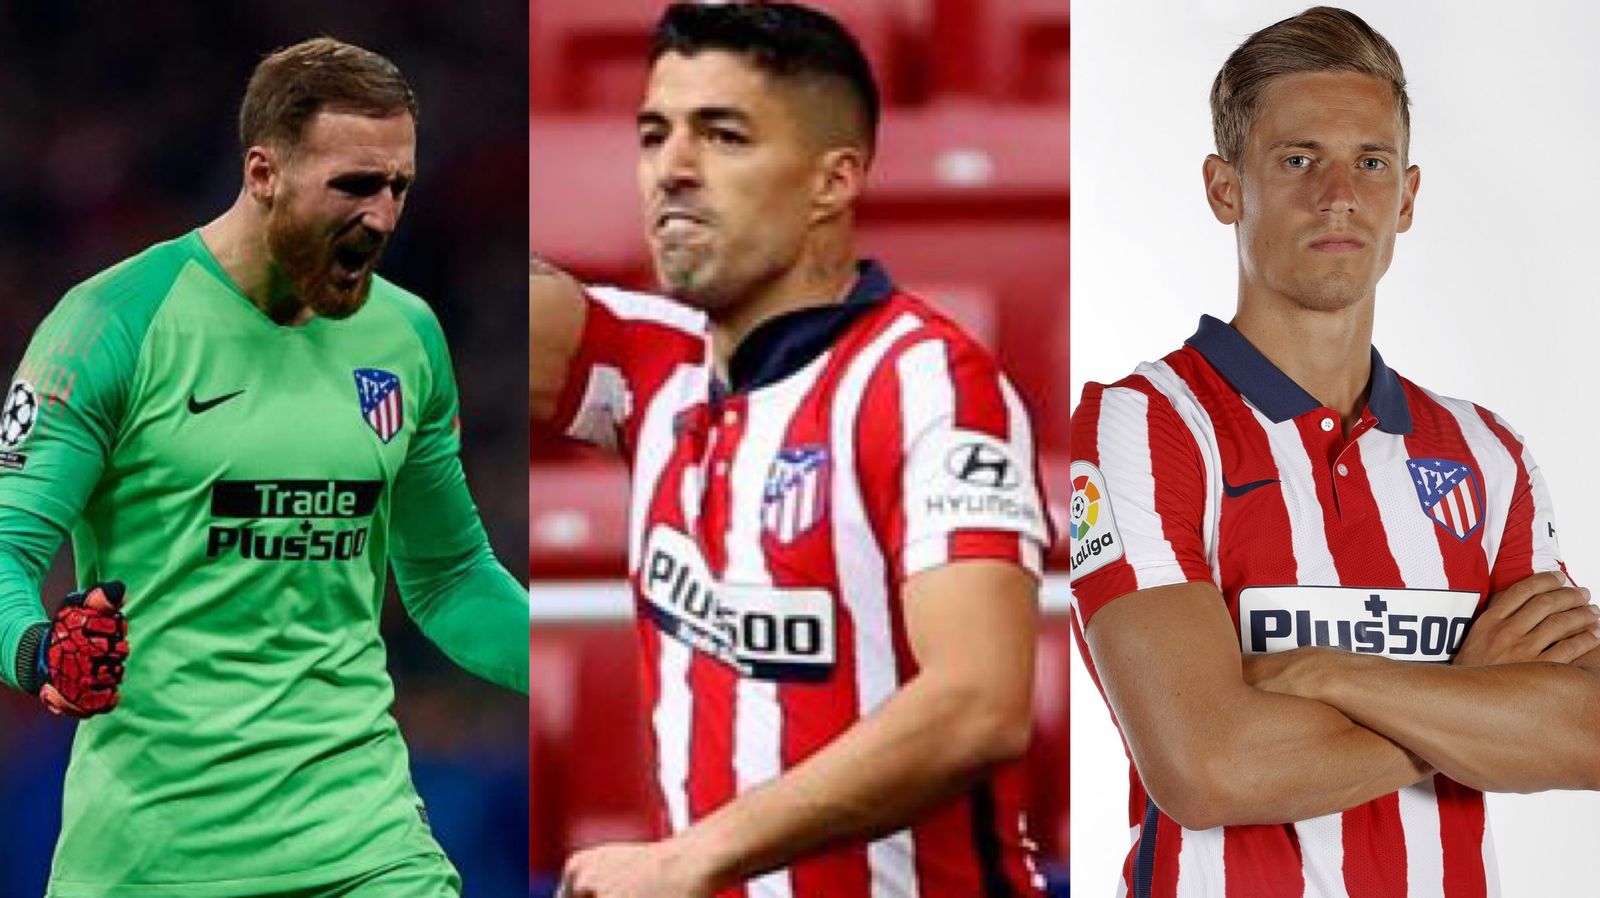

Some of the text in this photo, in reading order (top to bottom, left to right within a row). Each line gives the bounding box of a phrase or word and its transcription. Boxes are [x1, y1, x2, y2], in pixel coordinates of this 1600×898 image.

[254, 482, 357, 516] Trade
[926, 495, 1036, 520] HYUN
[206, 525, 368, 561] Plus500
[1070, 532, 1114, 571] LaLiga
[649, 550, 821, 656] Plu500
[1249, 608, 1471, 656] Plus500
